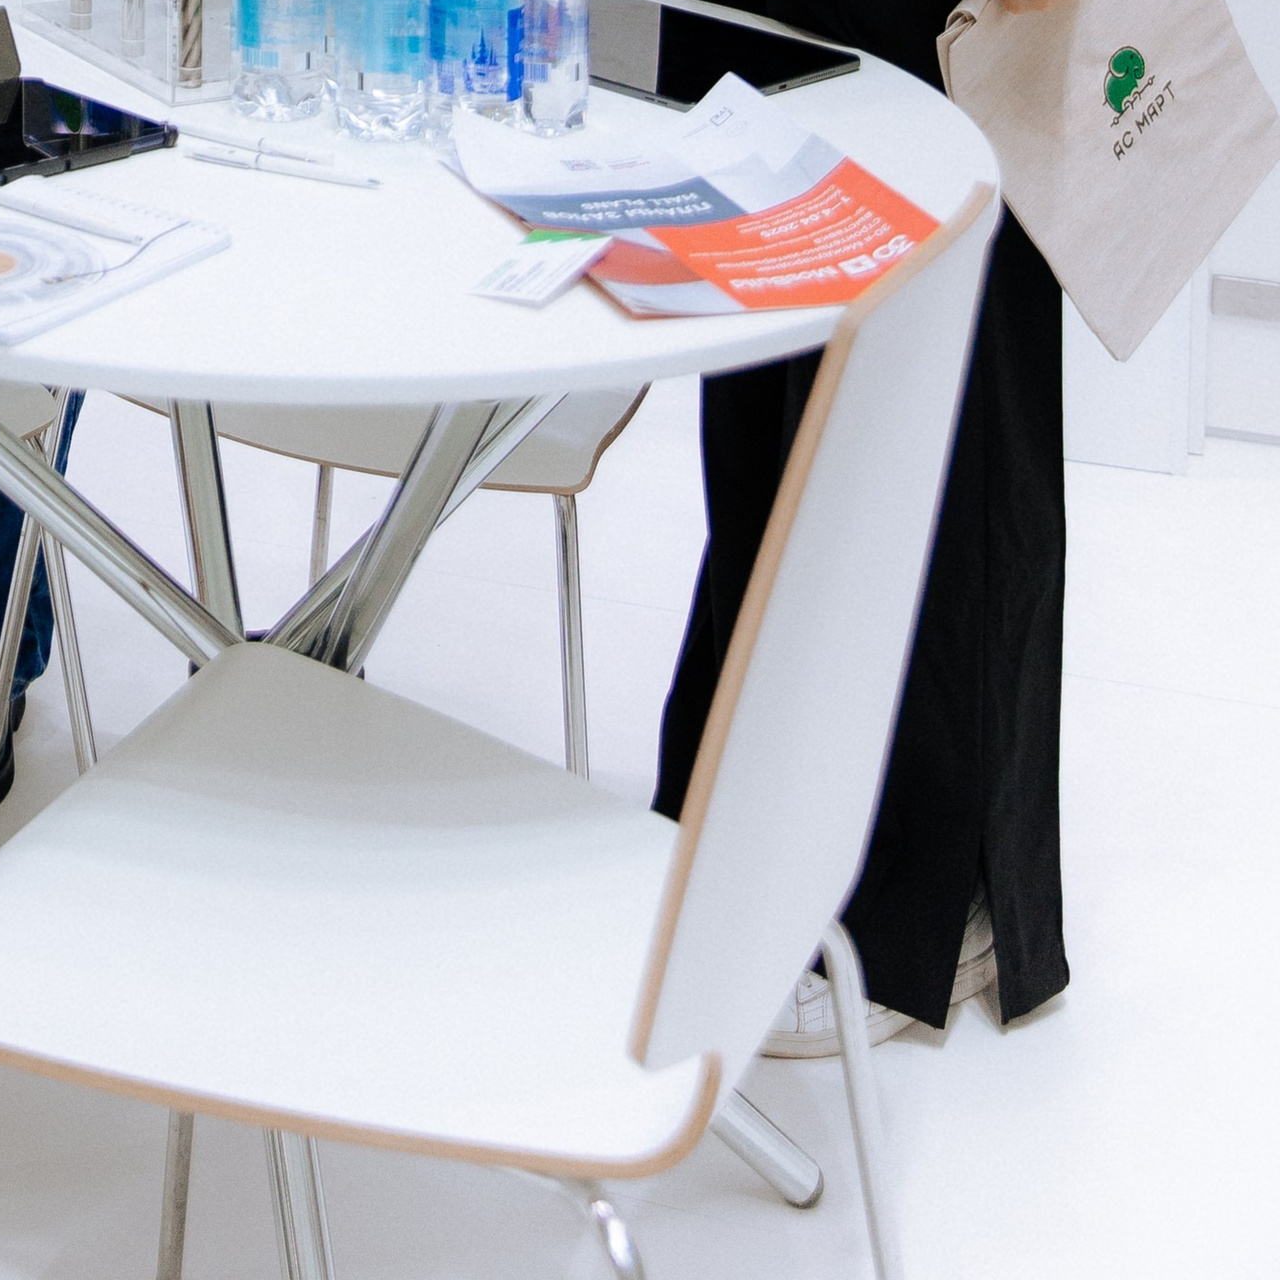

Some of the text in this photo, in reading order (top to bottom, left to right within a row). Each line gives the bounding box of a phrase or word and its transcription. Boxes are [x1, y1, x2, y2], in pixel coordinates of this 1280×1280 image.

[1135, 80, 1176, 134] МАРТ
[541, 201, 713, 223] ПЛАНЫ ЗАЛОВ
[580, 192, 699, 211] HALL PLANS
[729, 265, 839, 289] MosBuild
